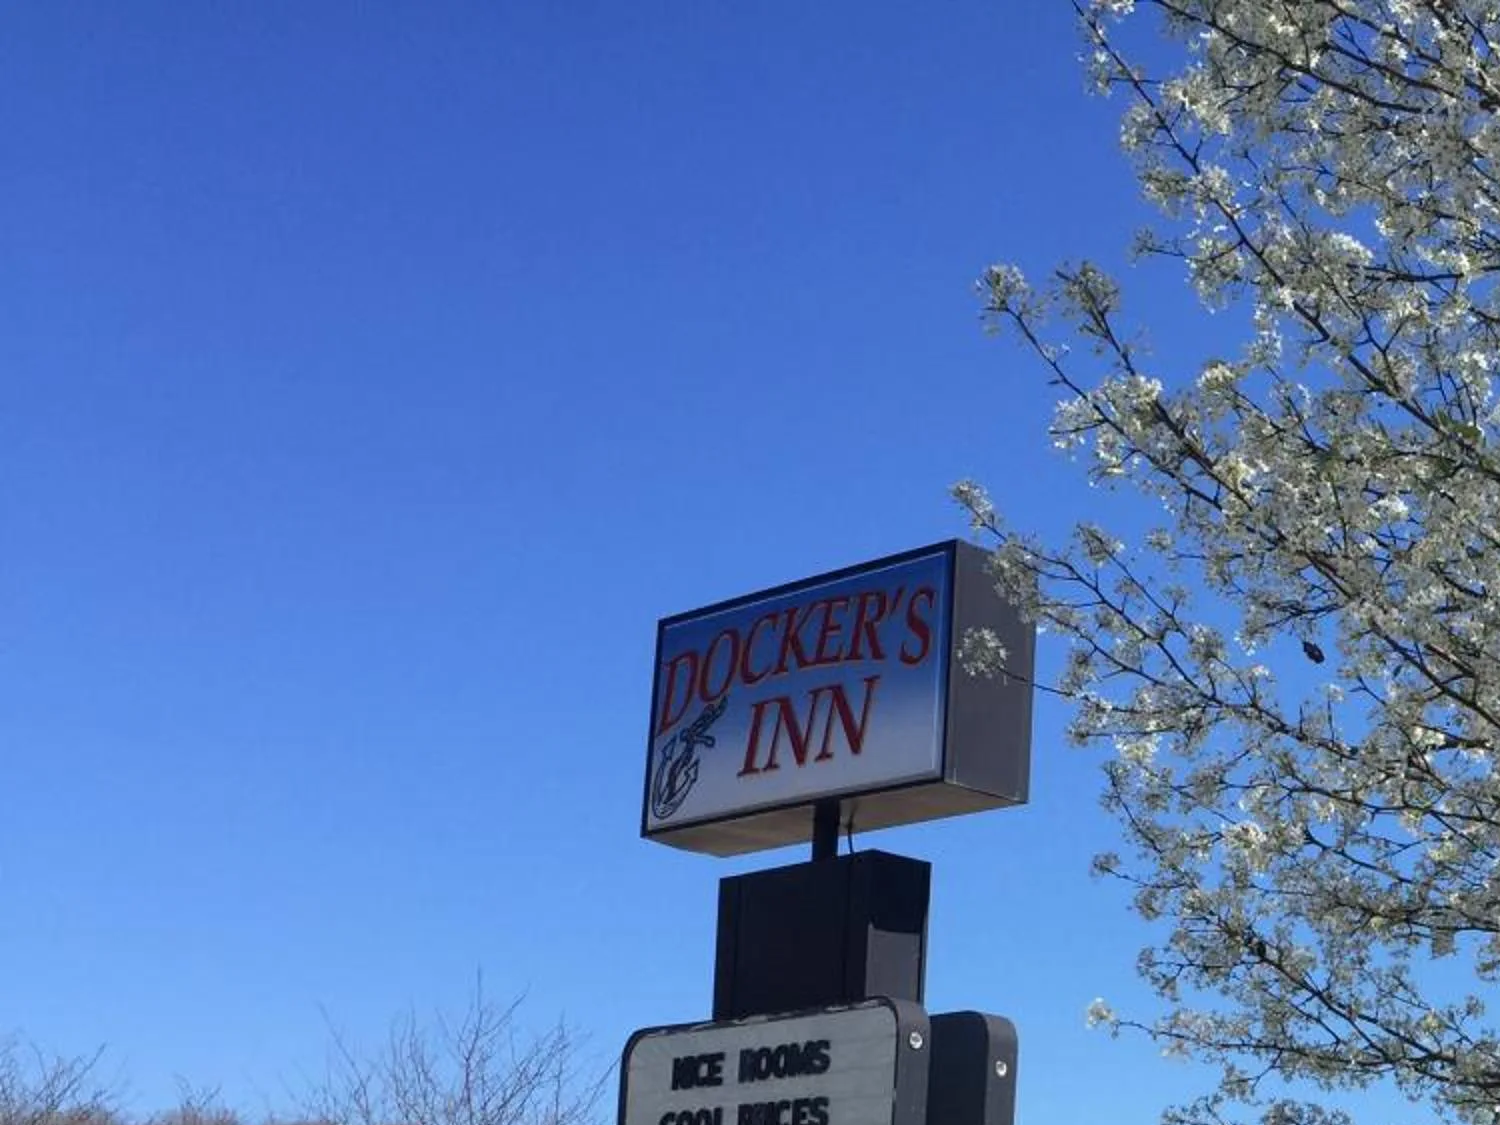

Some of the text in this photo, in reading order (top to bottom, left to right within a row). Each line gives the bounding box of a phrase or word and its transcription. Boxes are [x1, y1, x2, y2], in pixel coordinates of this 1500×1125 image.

[656, 587, 935, 737] DOCKER'S
[737, 675, 881, 778] INN
[671, 1039, 831, 1091] NICE ROOMS
